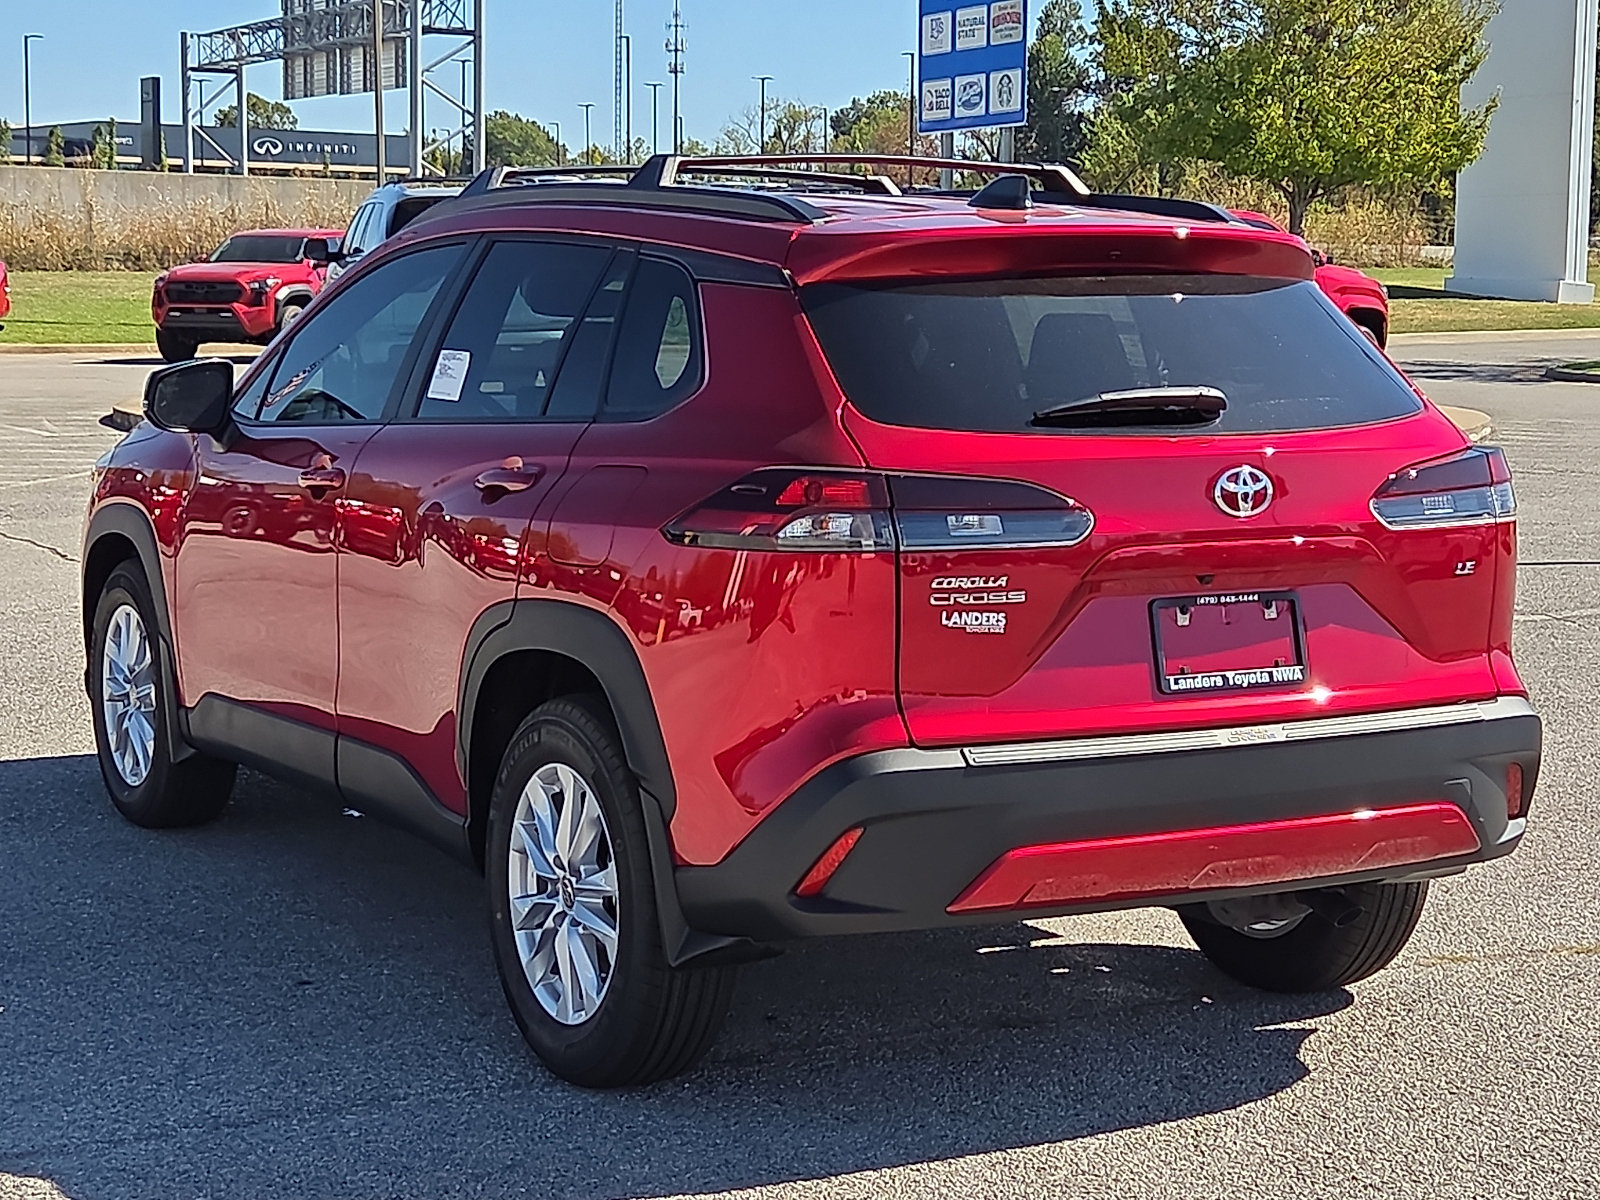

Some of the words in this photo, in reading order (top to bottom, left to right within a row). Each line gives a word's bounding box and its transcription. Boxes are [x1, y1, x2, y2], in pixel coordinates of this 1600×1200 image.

[288, 142, 356, 154] INFINITI
[1454, 561, 1476, 575] LE
[931, 576, 1008, 588] COROLLA
[930, 591, 1026, 605] CROSS
[941, 611, 1006, 627] LANDERS
[1168, 676, 1223, 690] Landers
[1226, 671, 1270, 687] Toyota
[1272, 668, 1304, 682] NWA
